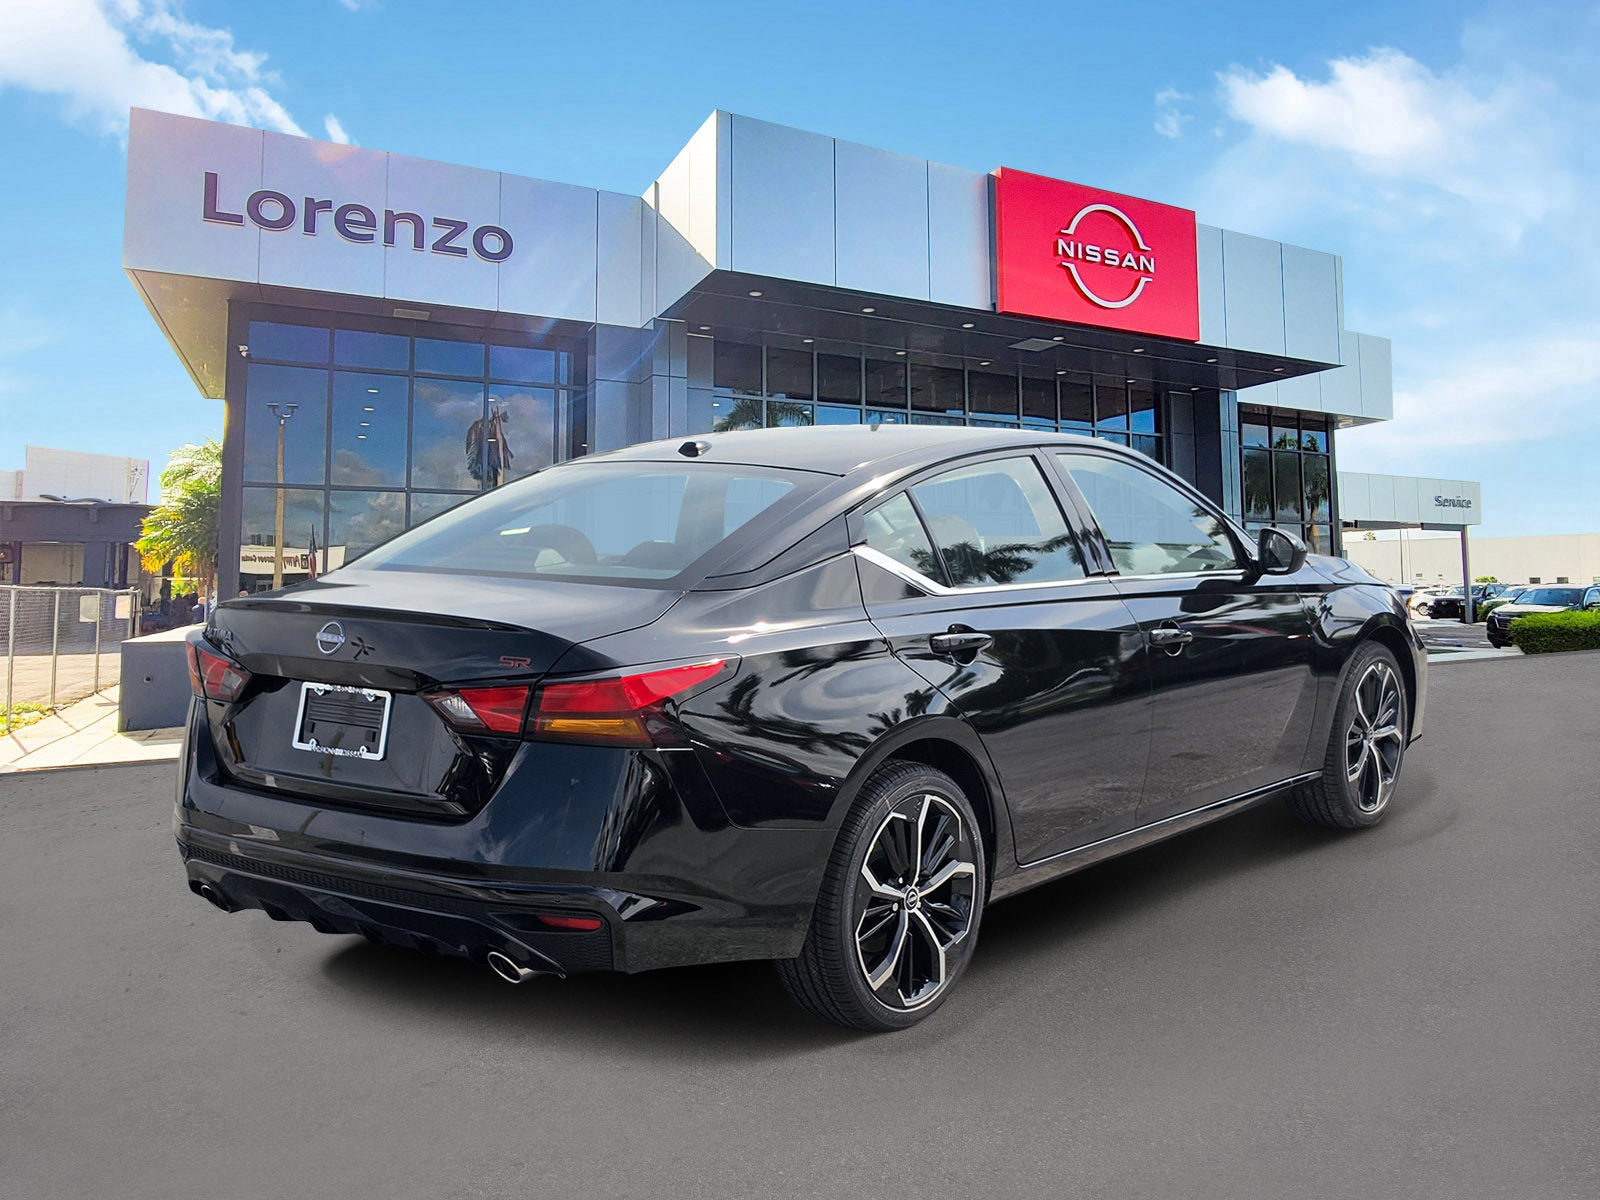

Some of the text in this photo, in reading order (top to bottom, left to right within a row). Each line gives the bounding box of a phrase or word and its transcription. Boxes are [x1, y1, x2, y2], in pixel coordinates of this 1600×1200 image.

[202, 171, 514, 263] Lorenzo
[1057, 238, 1155, 273] NISSAN
[1434, 495, 1472, 508] Service
[499, 655, 532, 669] SR
